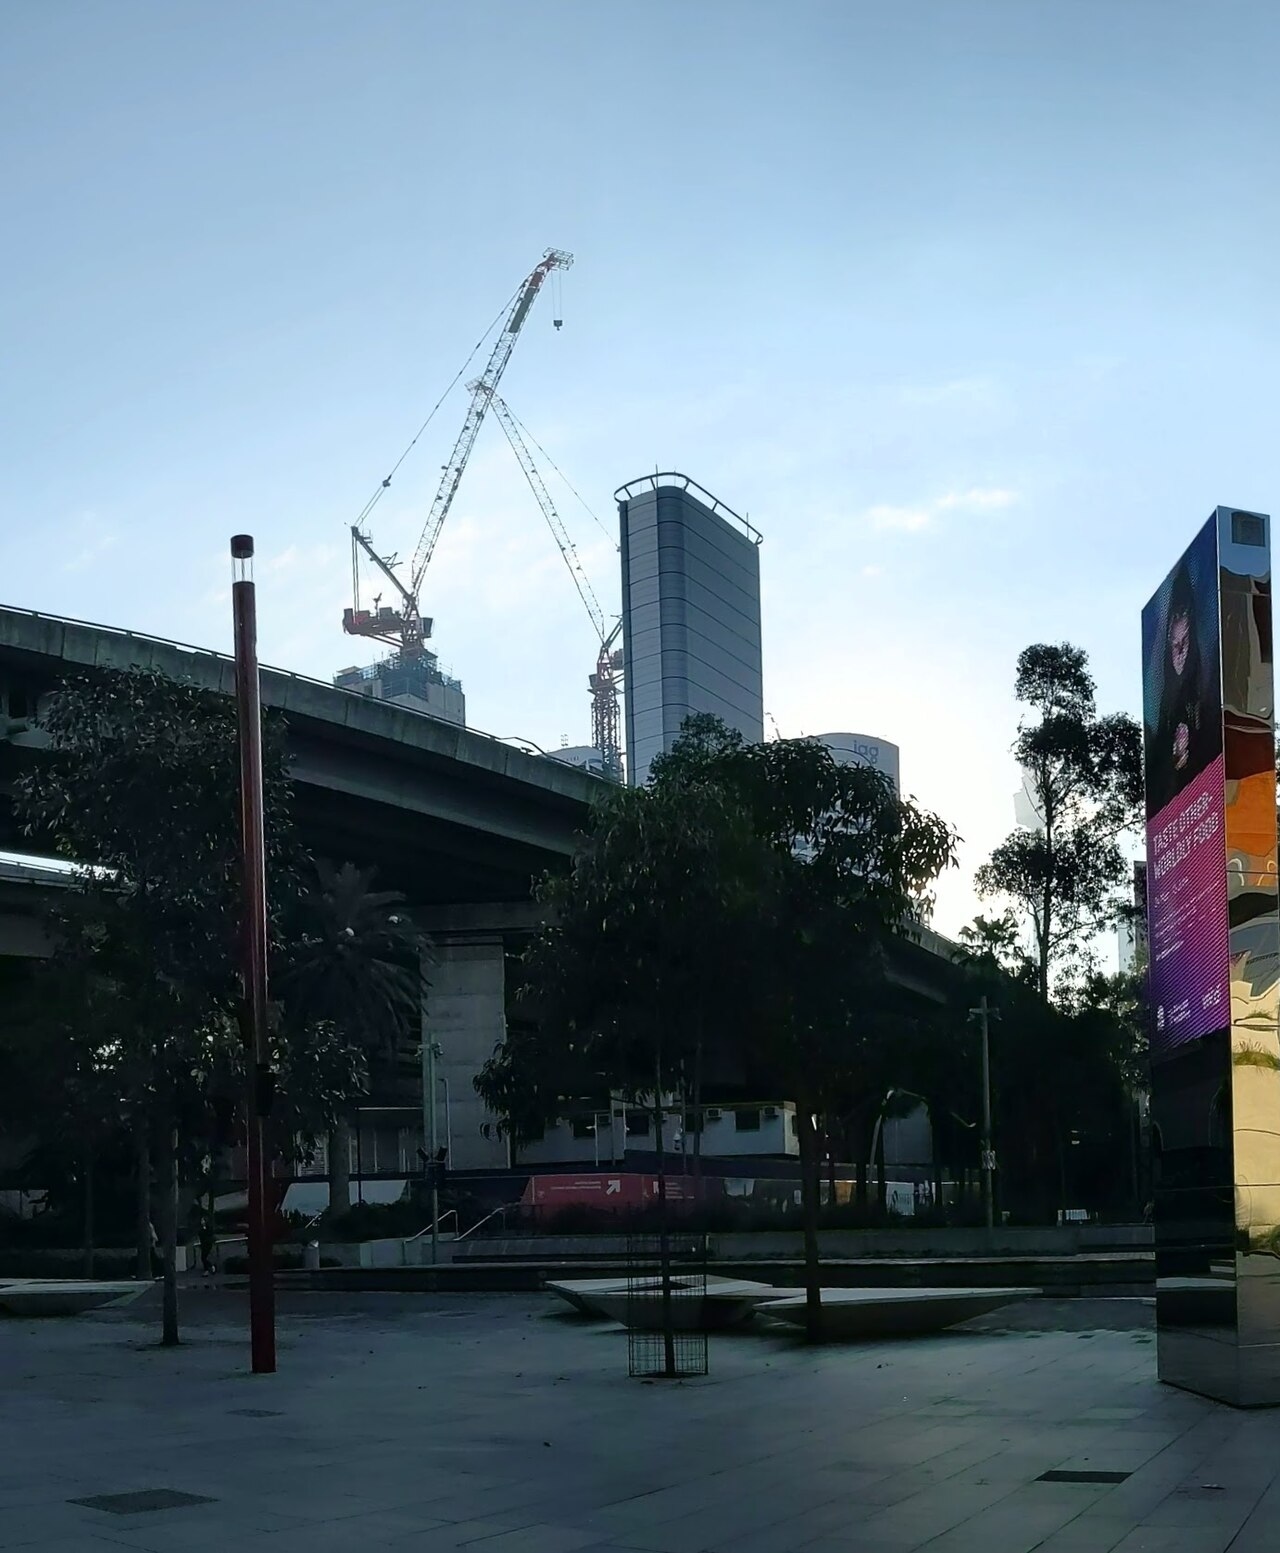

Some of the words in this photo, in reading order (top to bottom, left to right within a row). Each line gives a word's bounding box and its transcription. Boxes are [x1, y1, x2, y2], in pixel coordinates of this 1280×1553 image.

[853, 740, 879, 764] iag
[1153, 818, 1178, 856] TASTE
[1194, 811, 1219, 851] FOOD
